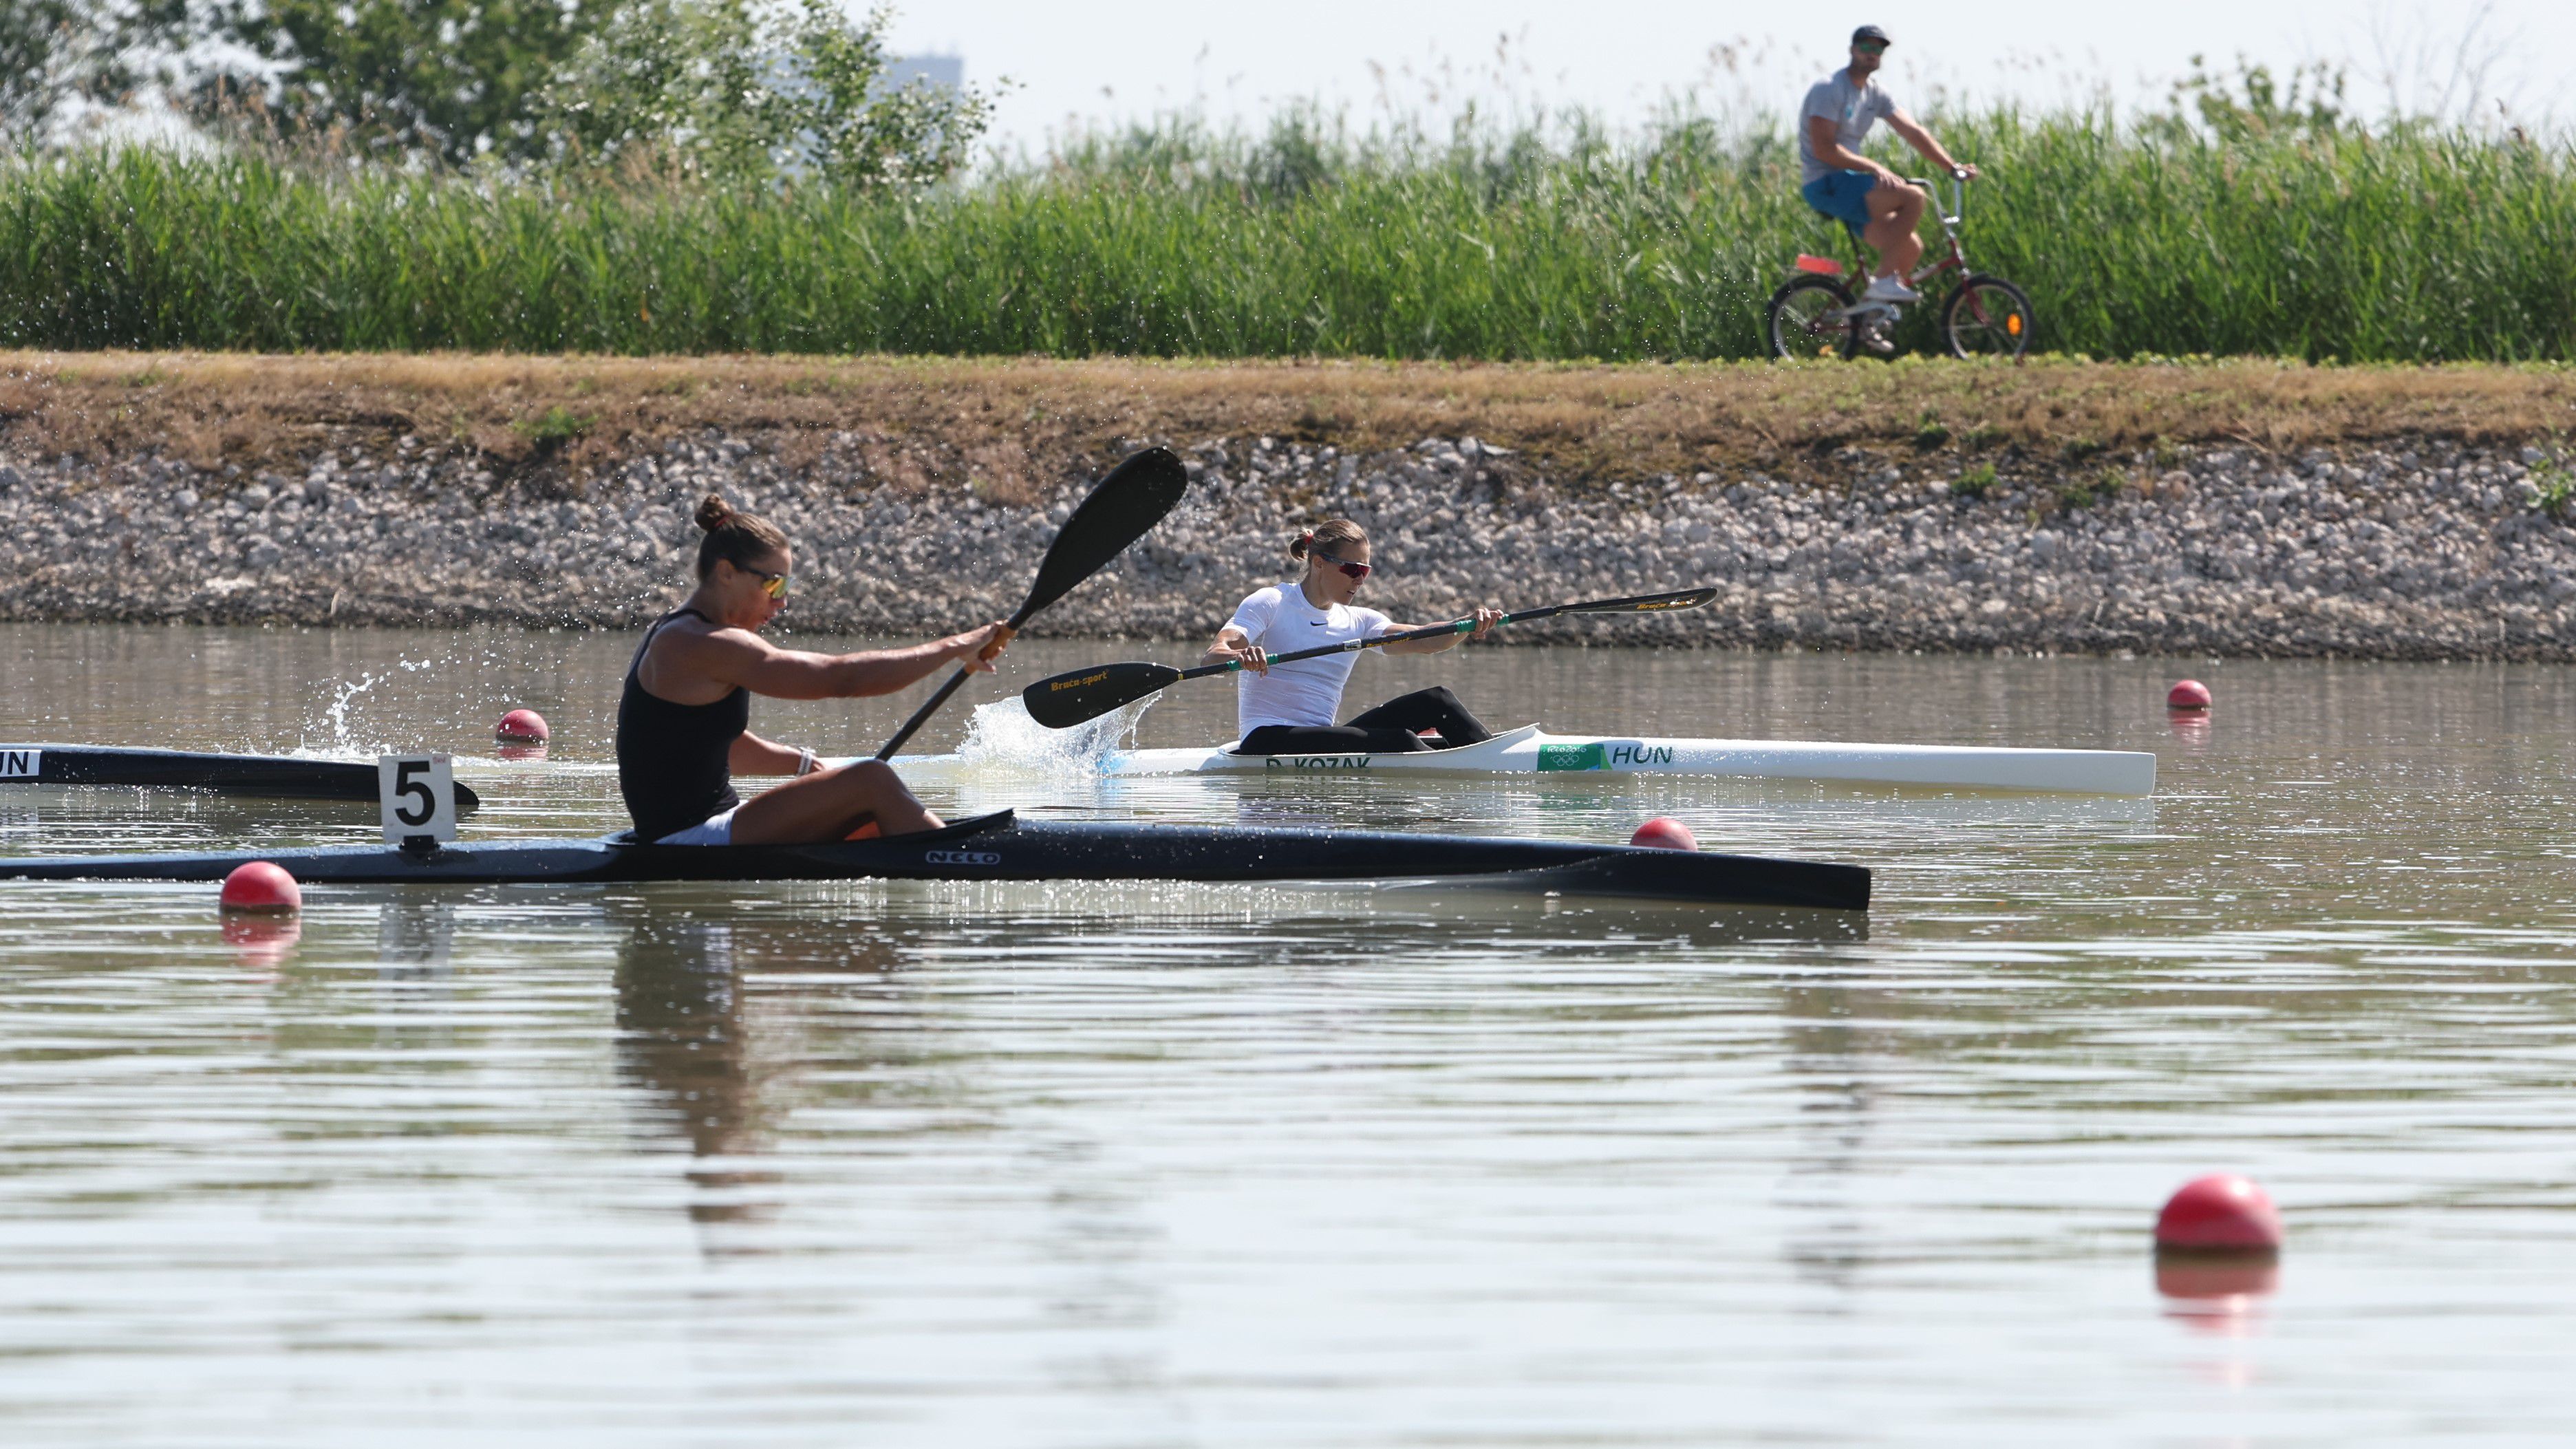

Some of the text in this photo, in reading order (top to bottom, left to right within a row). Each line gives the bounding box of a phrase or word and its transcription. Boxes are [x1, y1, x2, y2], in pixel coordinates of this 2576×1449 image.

[0, 751, 29, 775] N
[1613, 747, 1673, 764] HUN
[395, 760, 436, 826] 5
[928, 852, 998, 863] NELO
